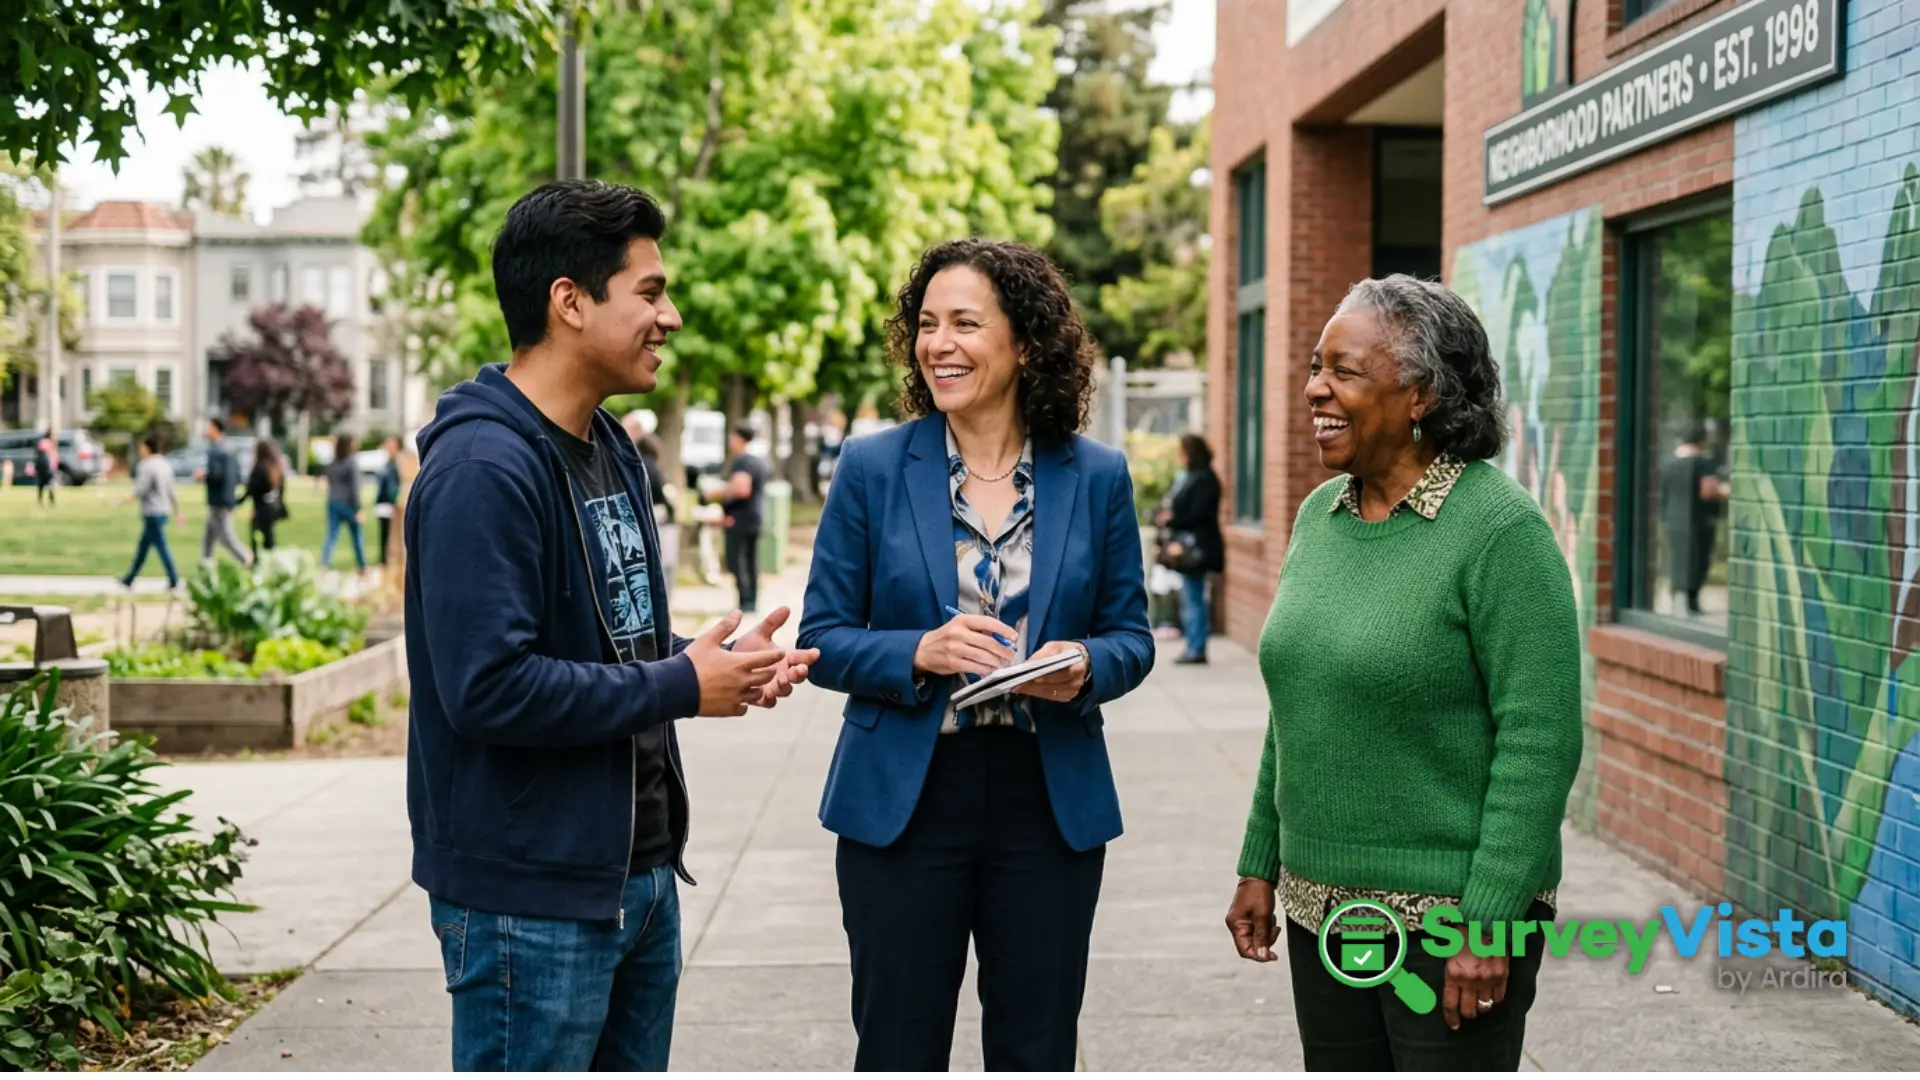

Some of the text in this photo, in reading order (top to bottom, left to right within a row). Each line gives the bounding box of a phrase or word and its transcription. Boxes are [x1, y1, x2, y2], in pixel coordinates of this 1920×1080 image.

[1488, 0, 1819, 183] NEIGHBORHOOD PARTNERS EST. 1998
